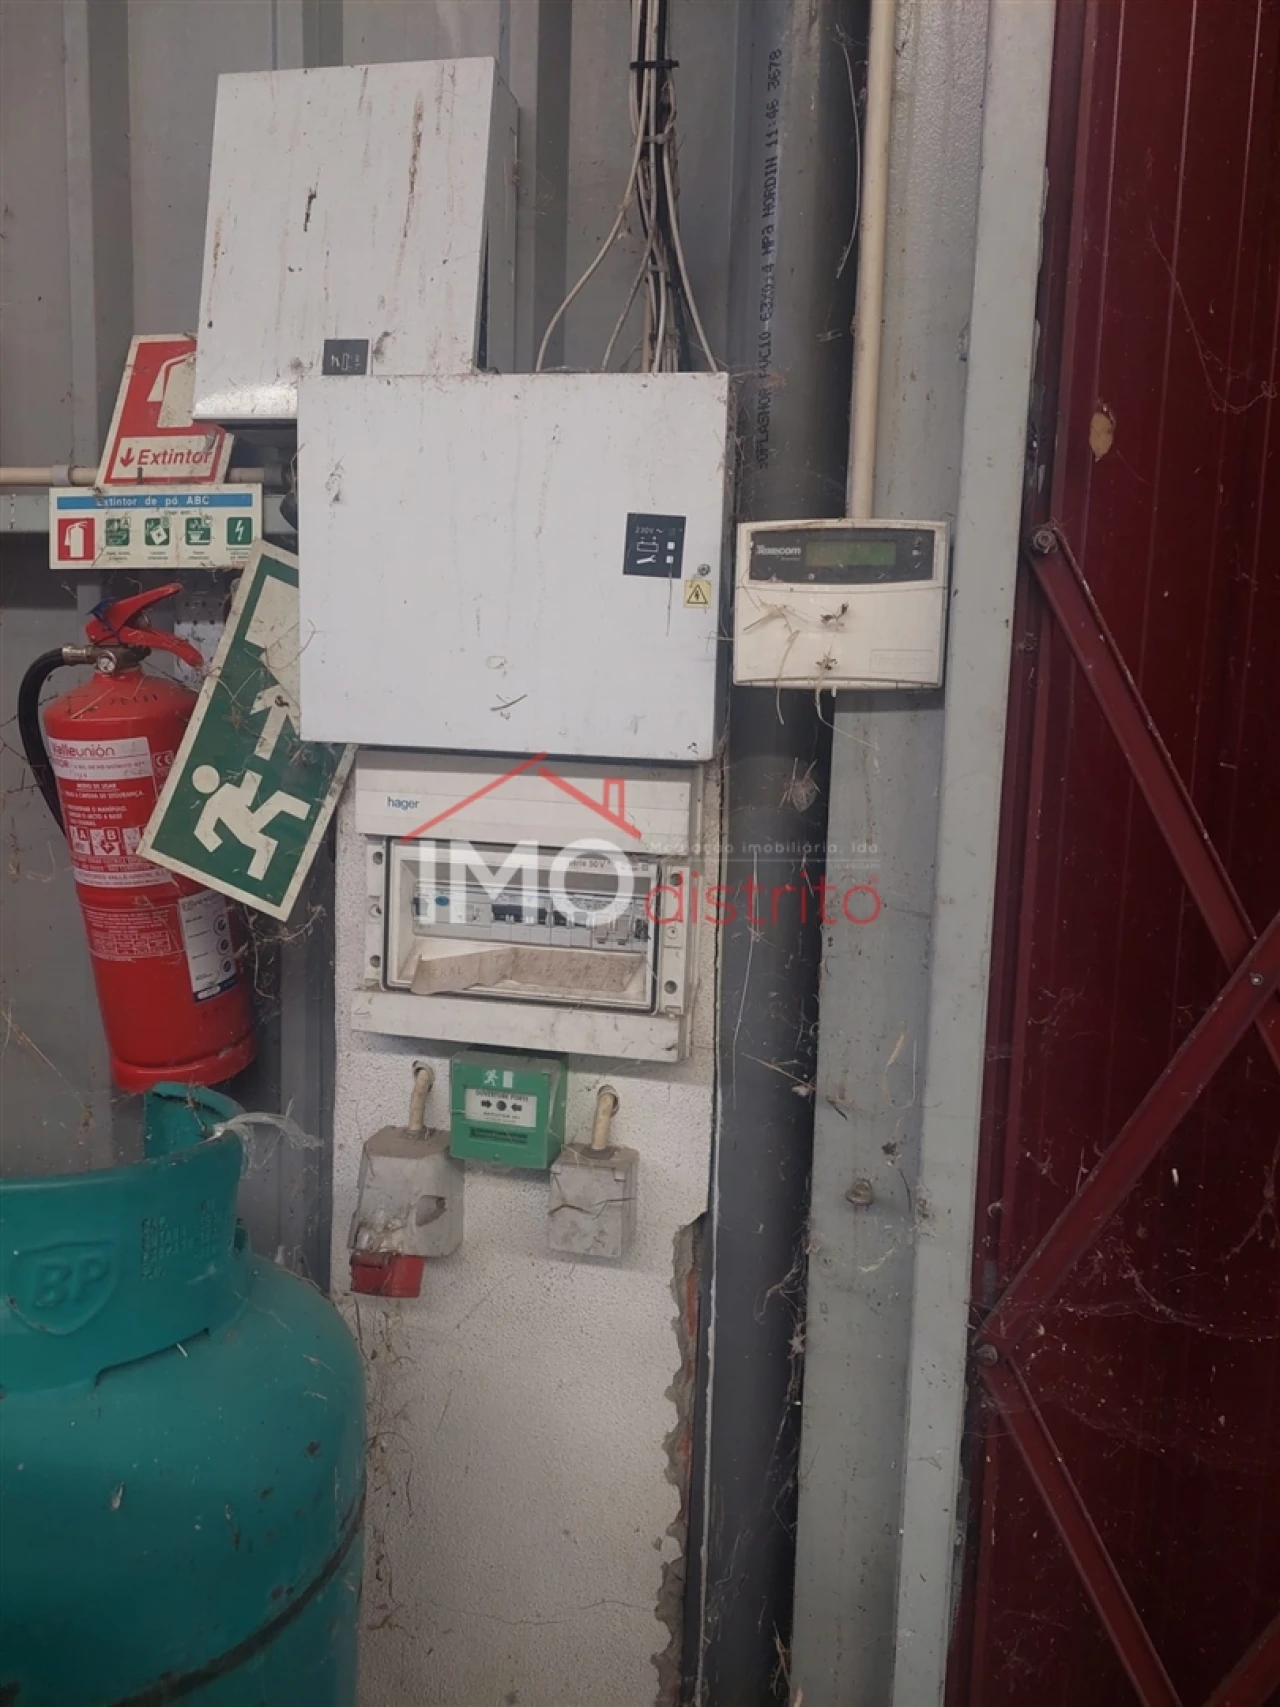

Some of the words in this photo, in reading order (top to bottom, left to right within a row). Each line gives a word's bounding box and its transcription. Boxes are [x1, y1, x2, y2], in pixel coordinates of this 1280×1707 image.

[766, 48, 782, 92] 3678
[764, 99, 779, 148] 11:46
[136, 448, 213, 466] Extintor
[145, 495, 157, 506] de
[186, 495, 210, 506] ABC
[387, 796, 420, 810] hager
